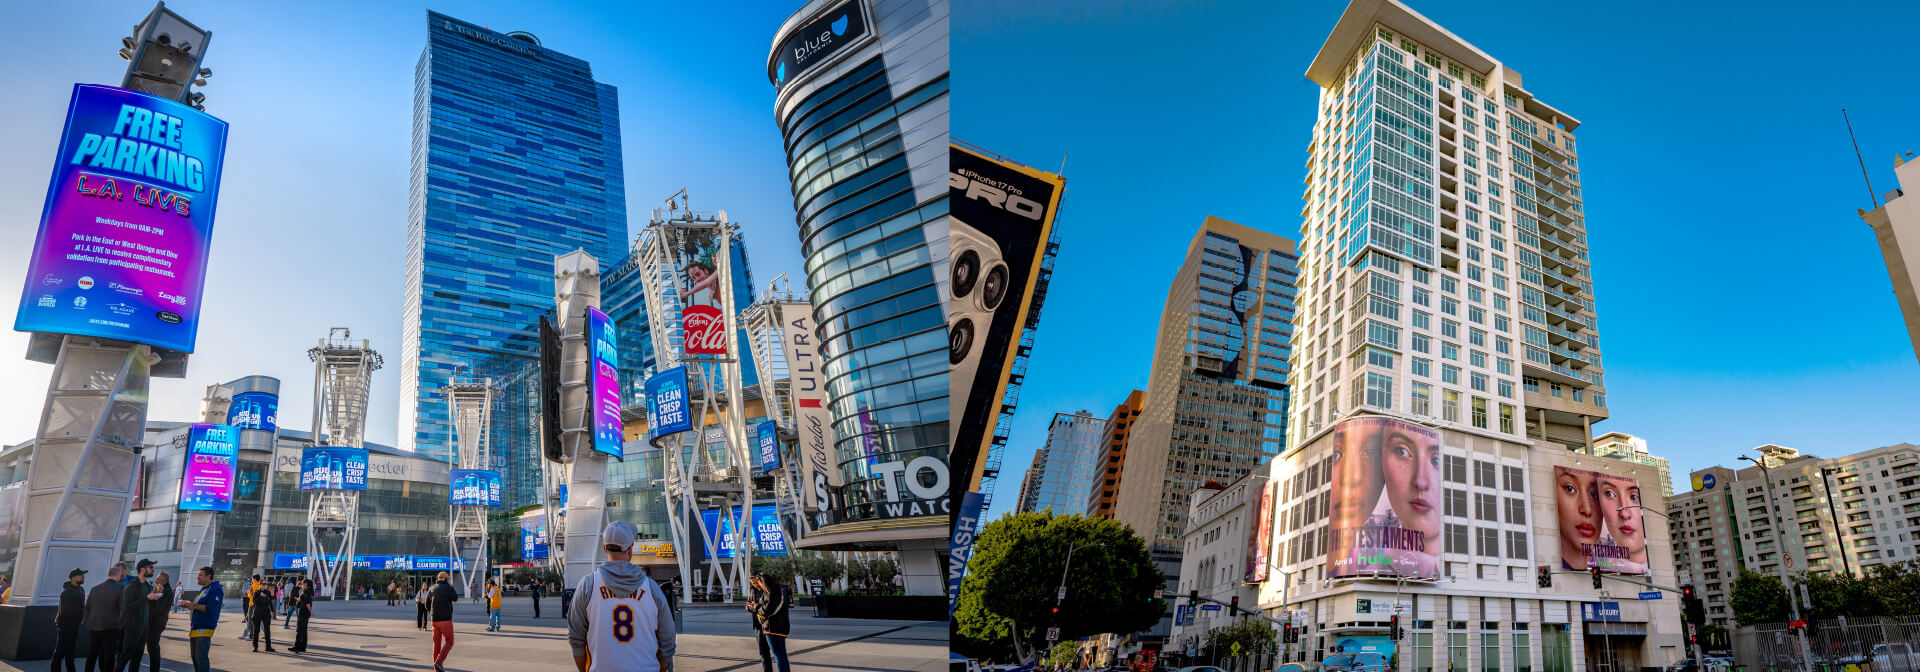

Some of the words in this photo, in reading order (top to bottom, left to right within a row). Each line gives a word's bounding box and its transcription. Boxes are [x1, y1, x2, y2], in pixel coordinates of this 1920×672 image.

[455, 25, 474, 37] THE
[794, 30, 831, 60] blue
[797, 40, 832, 64] CALIFORNIA
[112, 104, 183, 150] FREE
[71, 133, 204, 193] PARKING
[965, 170, 997, 186] iPhone
[997, 181, 1007, 190] 17
[1007, 185, 1023, 195] Pro
[77, 176, 123, 200] L.A.
[134, 184, 191, 216] LIVE
[96, 216, 124, 228] Weekdays
[125, 221, 138, 230] from
[72, 233, 85, 241] Park
[102, 237, 114, 245] East
[122, 240, 136, 249] West
[136, 243, 155, 253] Garage
[155, 248, 166, 256] and
[66, 253, 95, 263] validation
[94, 256, 108, 265] from
[108, 258, 144, 271] participating
[92, 245, 104, 254] LIVE
[111, 249, 132, 258] receive
[132, 252, 173, 268] complimentary
[688, 316, 708, 328] enjoy
[597, 339, 618, 369] PARK
[791, 317, 816, 391] ULTRA
[657, 389, 681, 404] CLEAN
[660, 401, 681, 415] CRISP
[660, 411, 683, 426] TASTE
[205, 428, 226, 441] FREE
[193, 440, 233, 455] PARKING
[804, 413, 828, 476] Michelob
[313, 467, 330, 475] BUD
[346, 461, 365, 469] CLEAN
[367, 460, 408, 475] eater
[346, 469, 364, 477] CRISP
[346, 476, 364, 484] TASTE
[870, 456, 949, 502] TO
[815, 474, 829, 512] S
[885, 498, 949, 518] WATC
[818, 513, 828, 526] AR
[758, 523, 782, 533] CLEAN
[724, 533, 739, 542] BU
[760, 532, 782, 541] CRISP
[1352, 526, 1425, 552] TESTAMENTS
[641, 543, 661, 556] Lazy
[660, 542, 673, 552] DOG
[721, 541, 745, 550] LIGT
[760, 541, 784, 550] TASTE
[950, 516, 976, 580] WASH
[1581, 543, 1592, 556] THE
[1593, 544, 1630, 560] TESTAMENTS
[1358, 552, 1391, 565] hulu
[612, 604, 635, 643] 8
